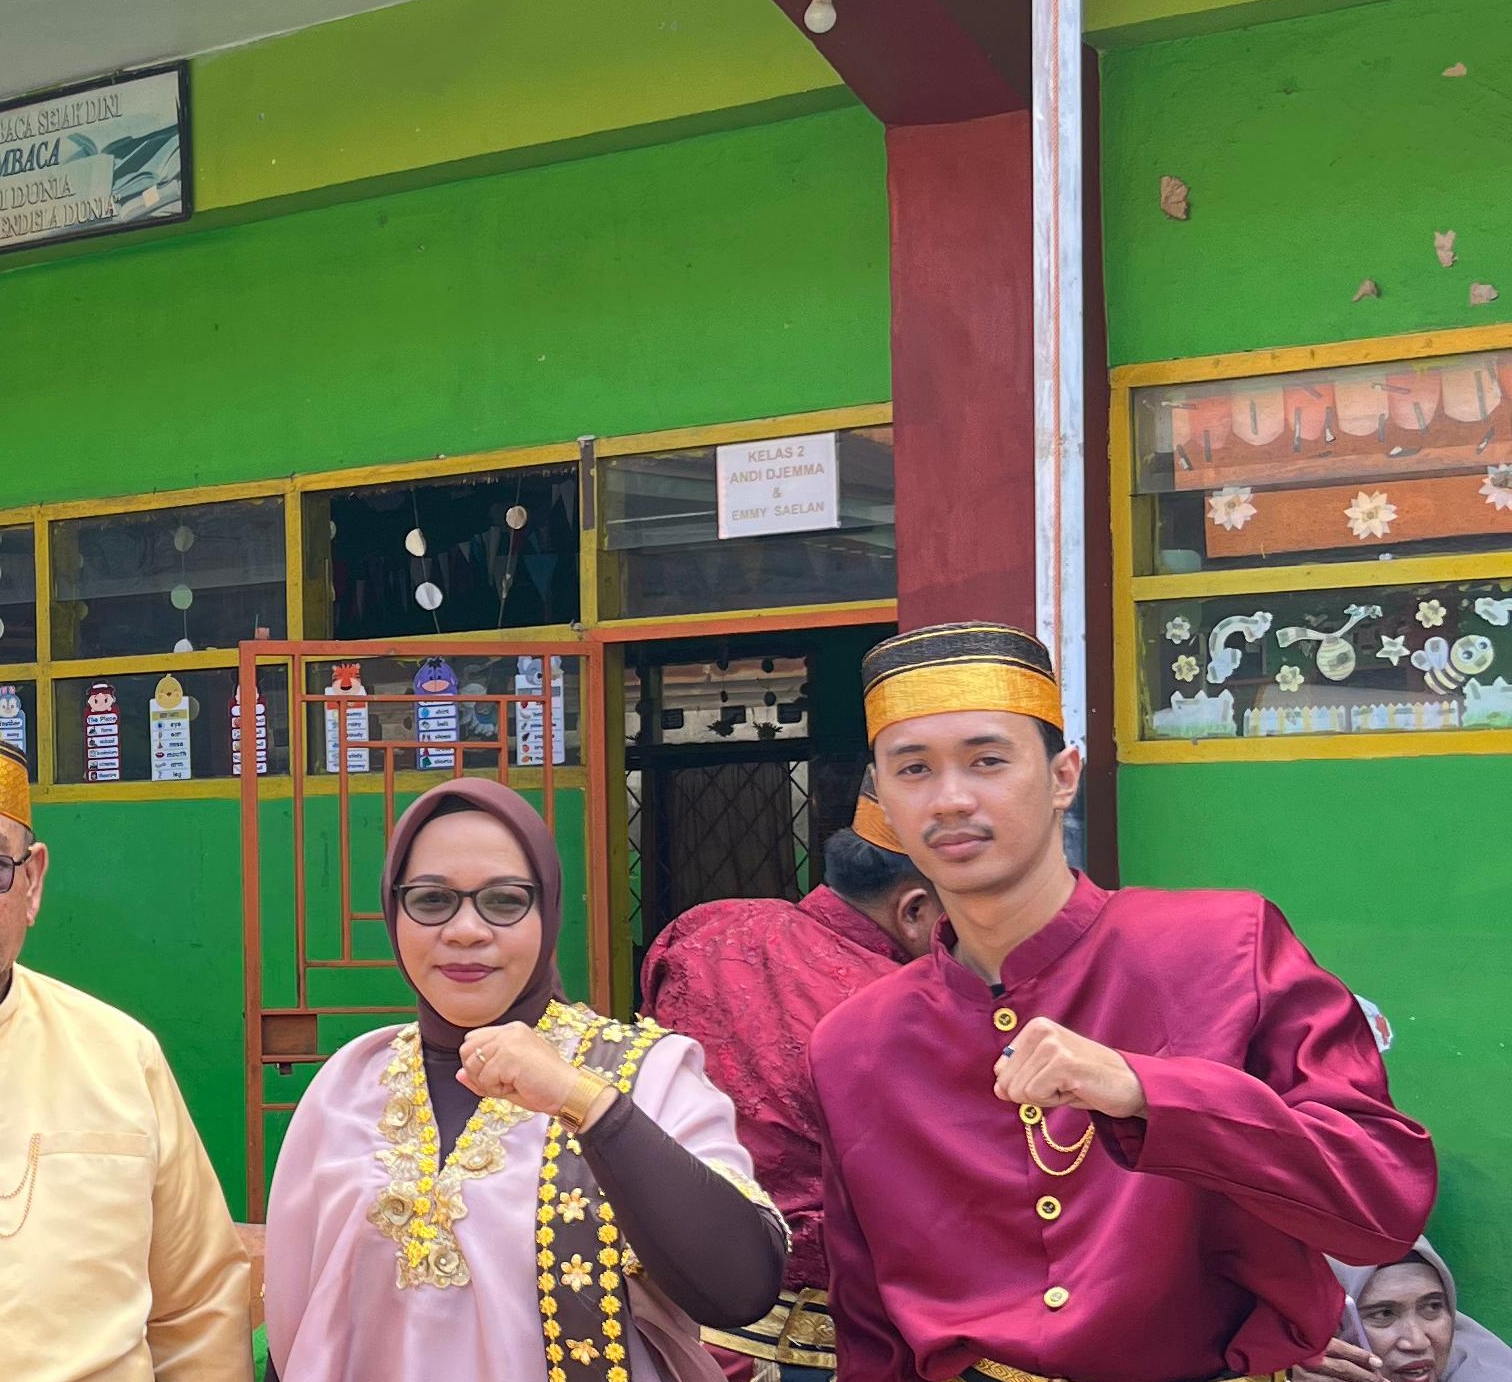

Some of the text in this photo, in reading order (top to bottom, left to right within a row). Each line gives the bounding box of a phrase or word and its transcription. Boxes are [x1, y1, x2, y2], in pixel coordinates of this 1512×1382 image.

[85, 93, 123, 126] DINI
[10, 174, 75, 209] DUNIA
[747, 445, 805, 463] KELAS 2
[729, 463, 825, 485] ANDI DJEMMA
[771, 487, 782, 499] &
[731, 501, 825, 521] EMMY SAELAN
